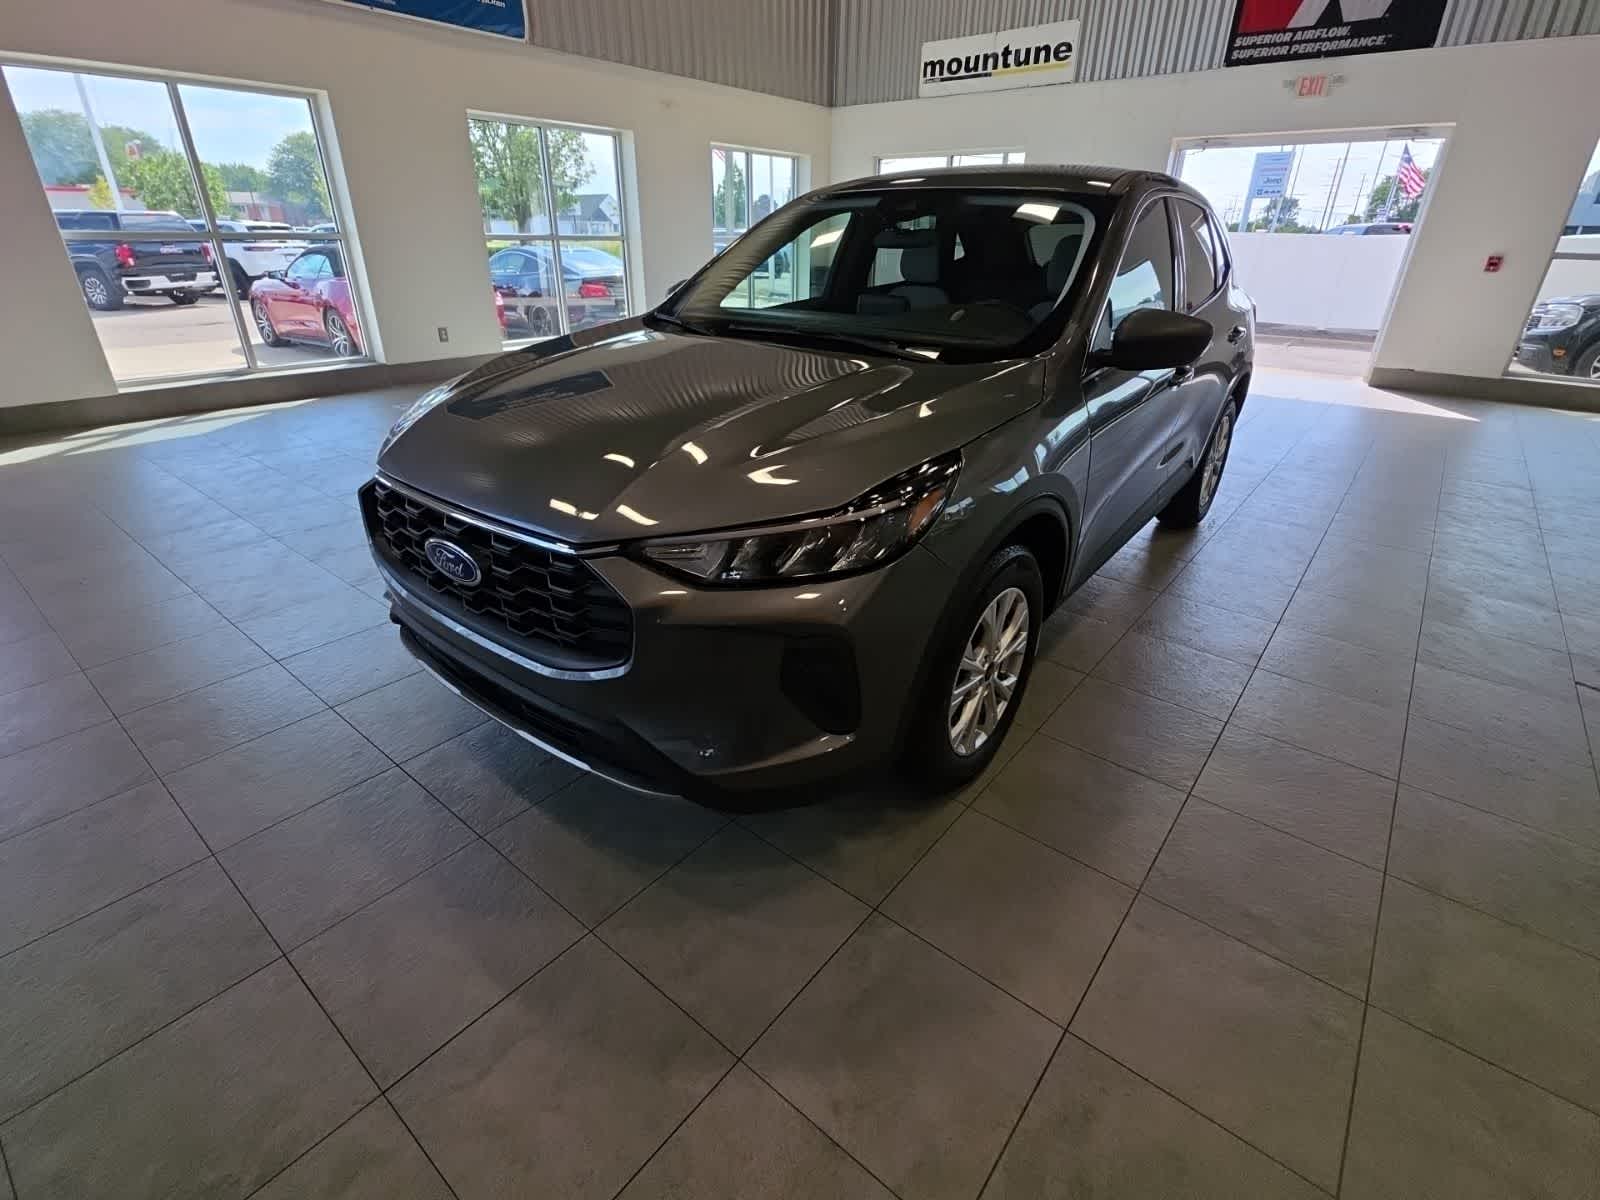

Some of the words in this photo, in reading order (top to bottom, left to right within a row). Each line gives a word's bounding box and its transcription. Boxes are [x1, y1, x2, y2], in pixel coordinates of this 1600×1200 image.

[1234, 31, 1293, 47] SUPERIOR
[1293, 25, 1351, 41] AIRFLOW.
[923, 41, 1073, 78] mountune
[1231, 44, 1290, 60] SUPERIOR
[1299, 76, 1326, 97] EXIT
[434, 547, 465, 577] Ford
